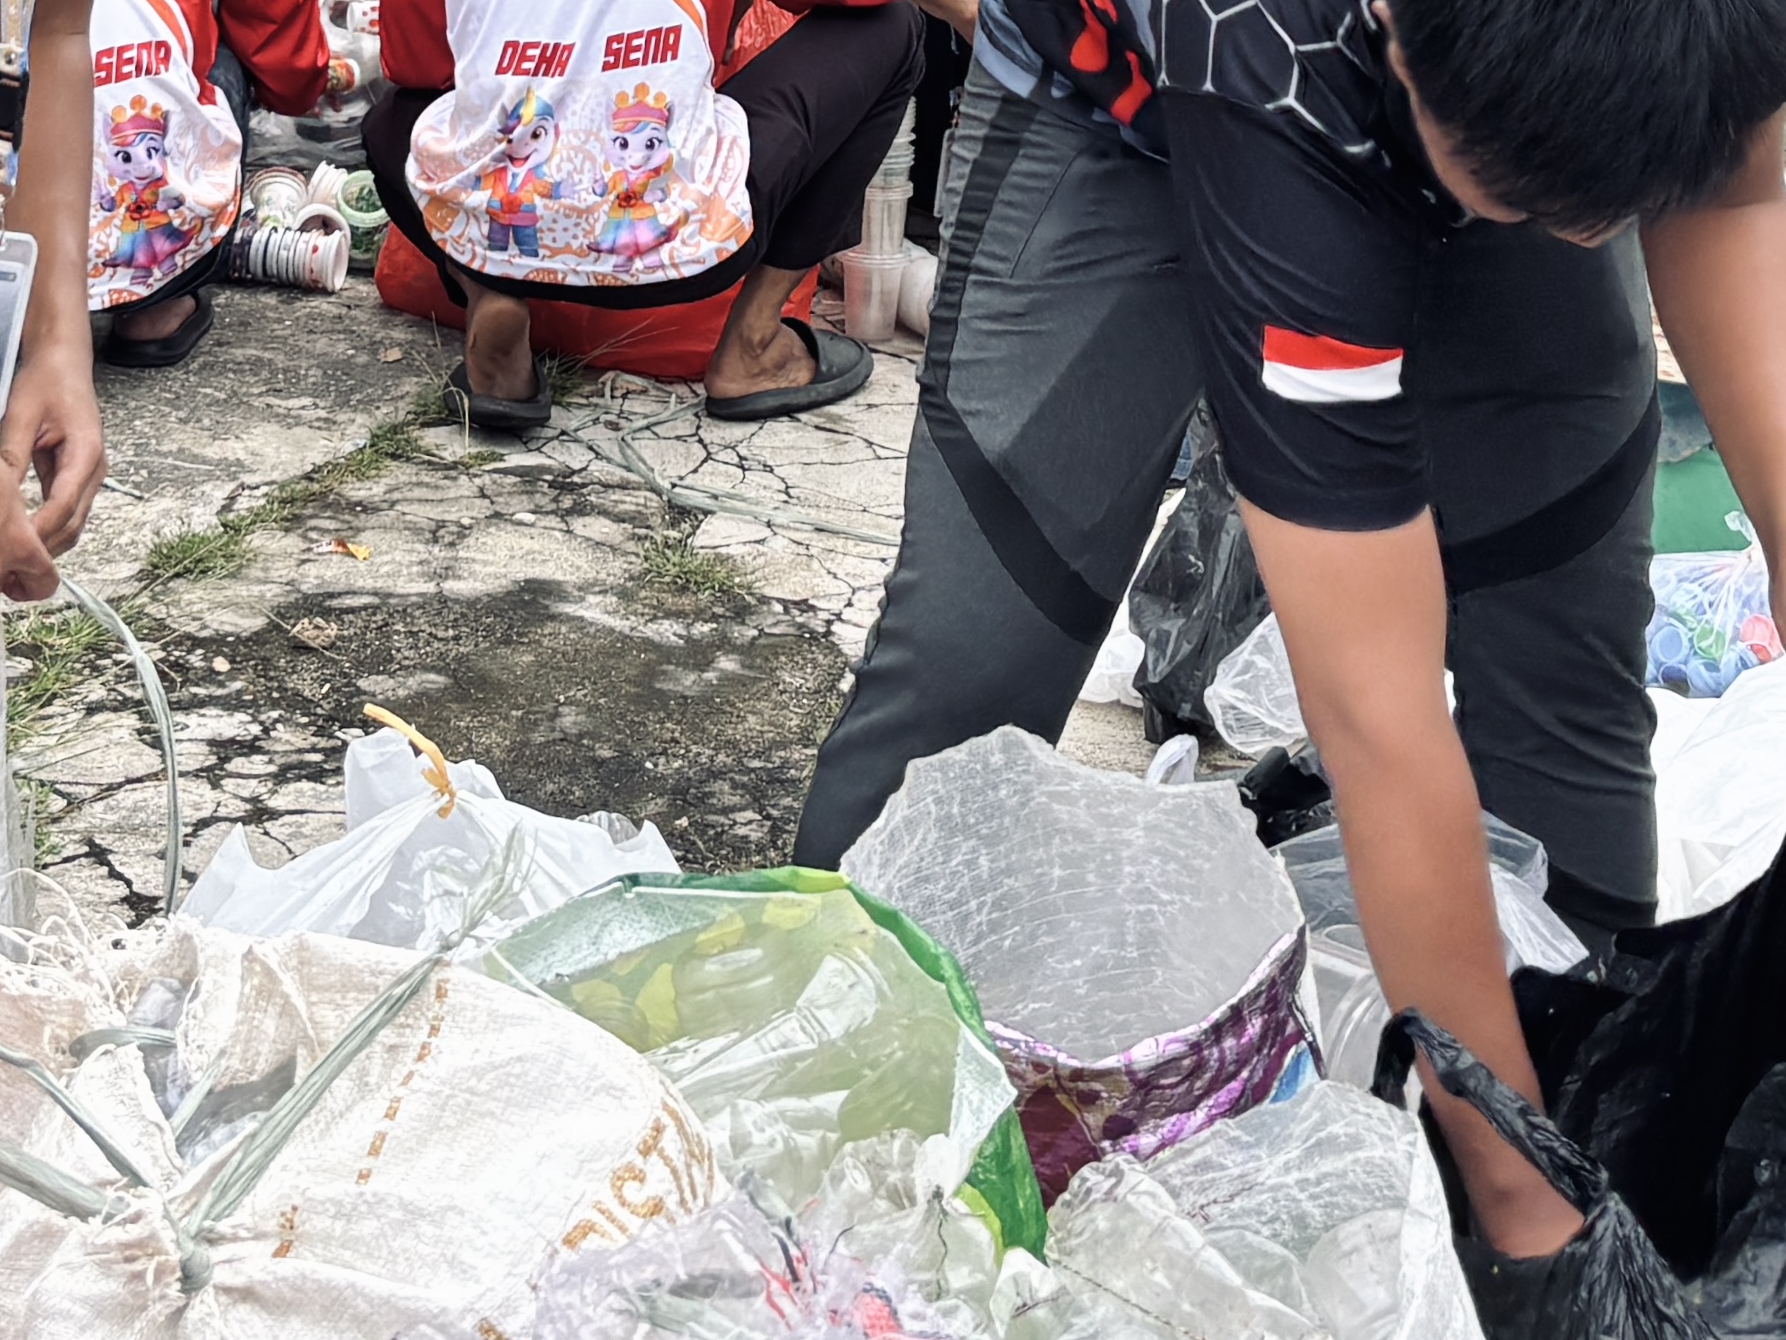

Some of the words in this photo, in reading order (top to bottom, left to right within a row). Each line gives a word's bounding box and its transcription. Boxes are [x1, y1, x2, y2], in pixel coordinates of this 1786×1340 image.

[93, 37, 171, 87] SENA
[494, 39, 577, 79] DEHA
[600, 23, 683, 74] SENA
